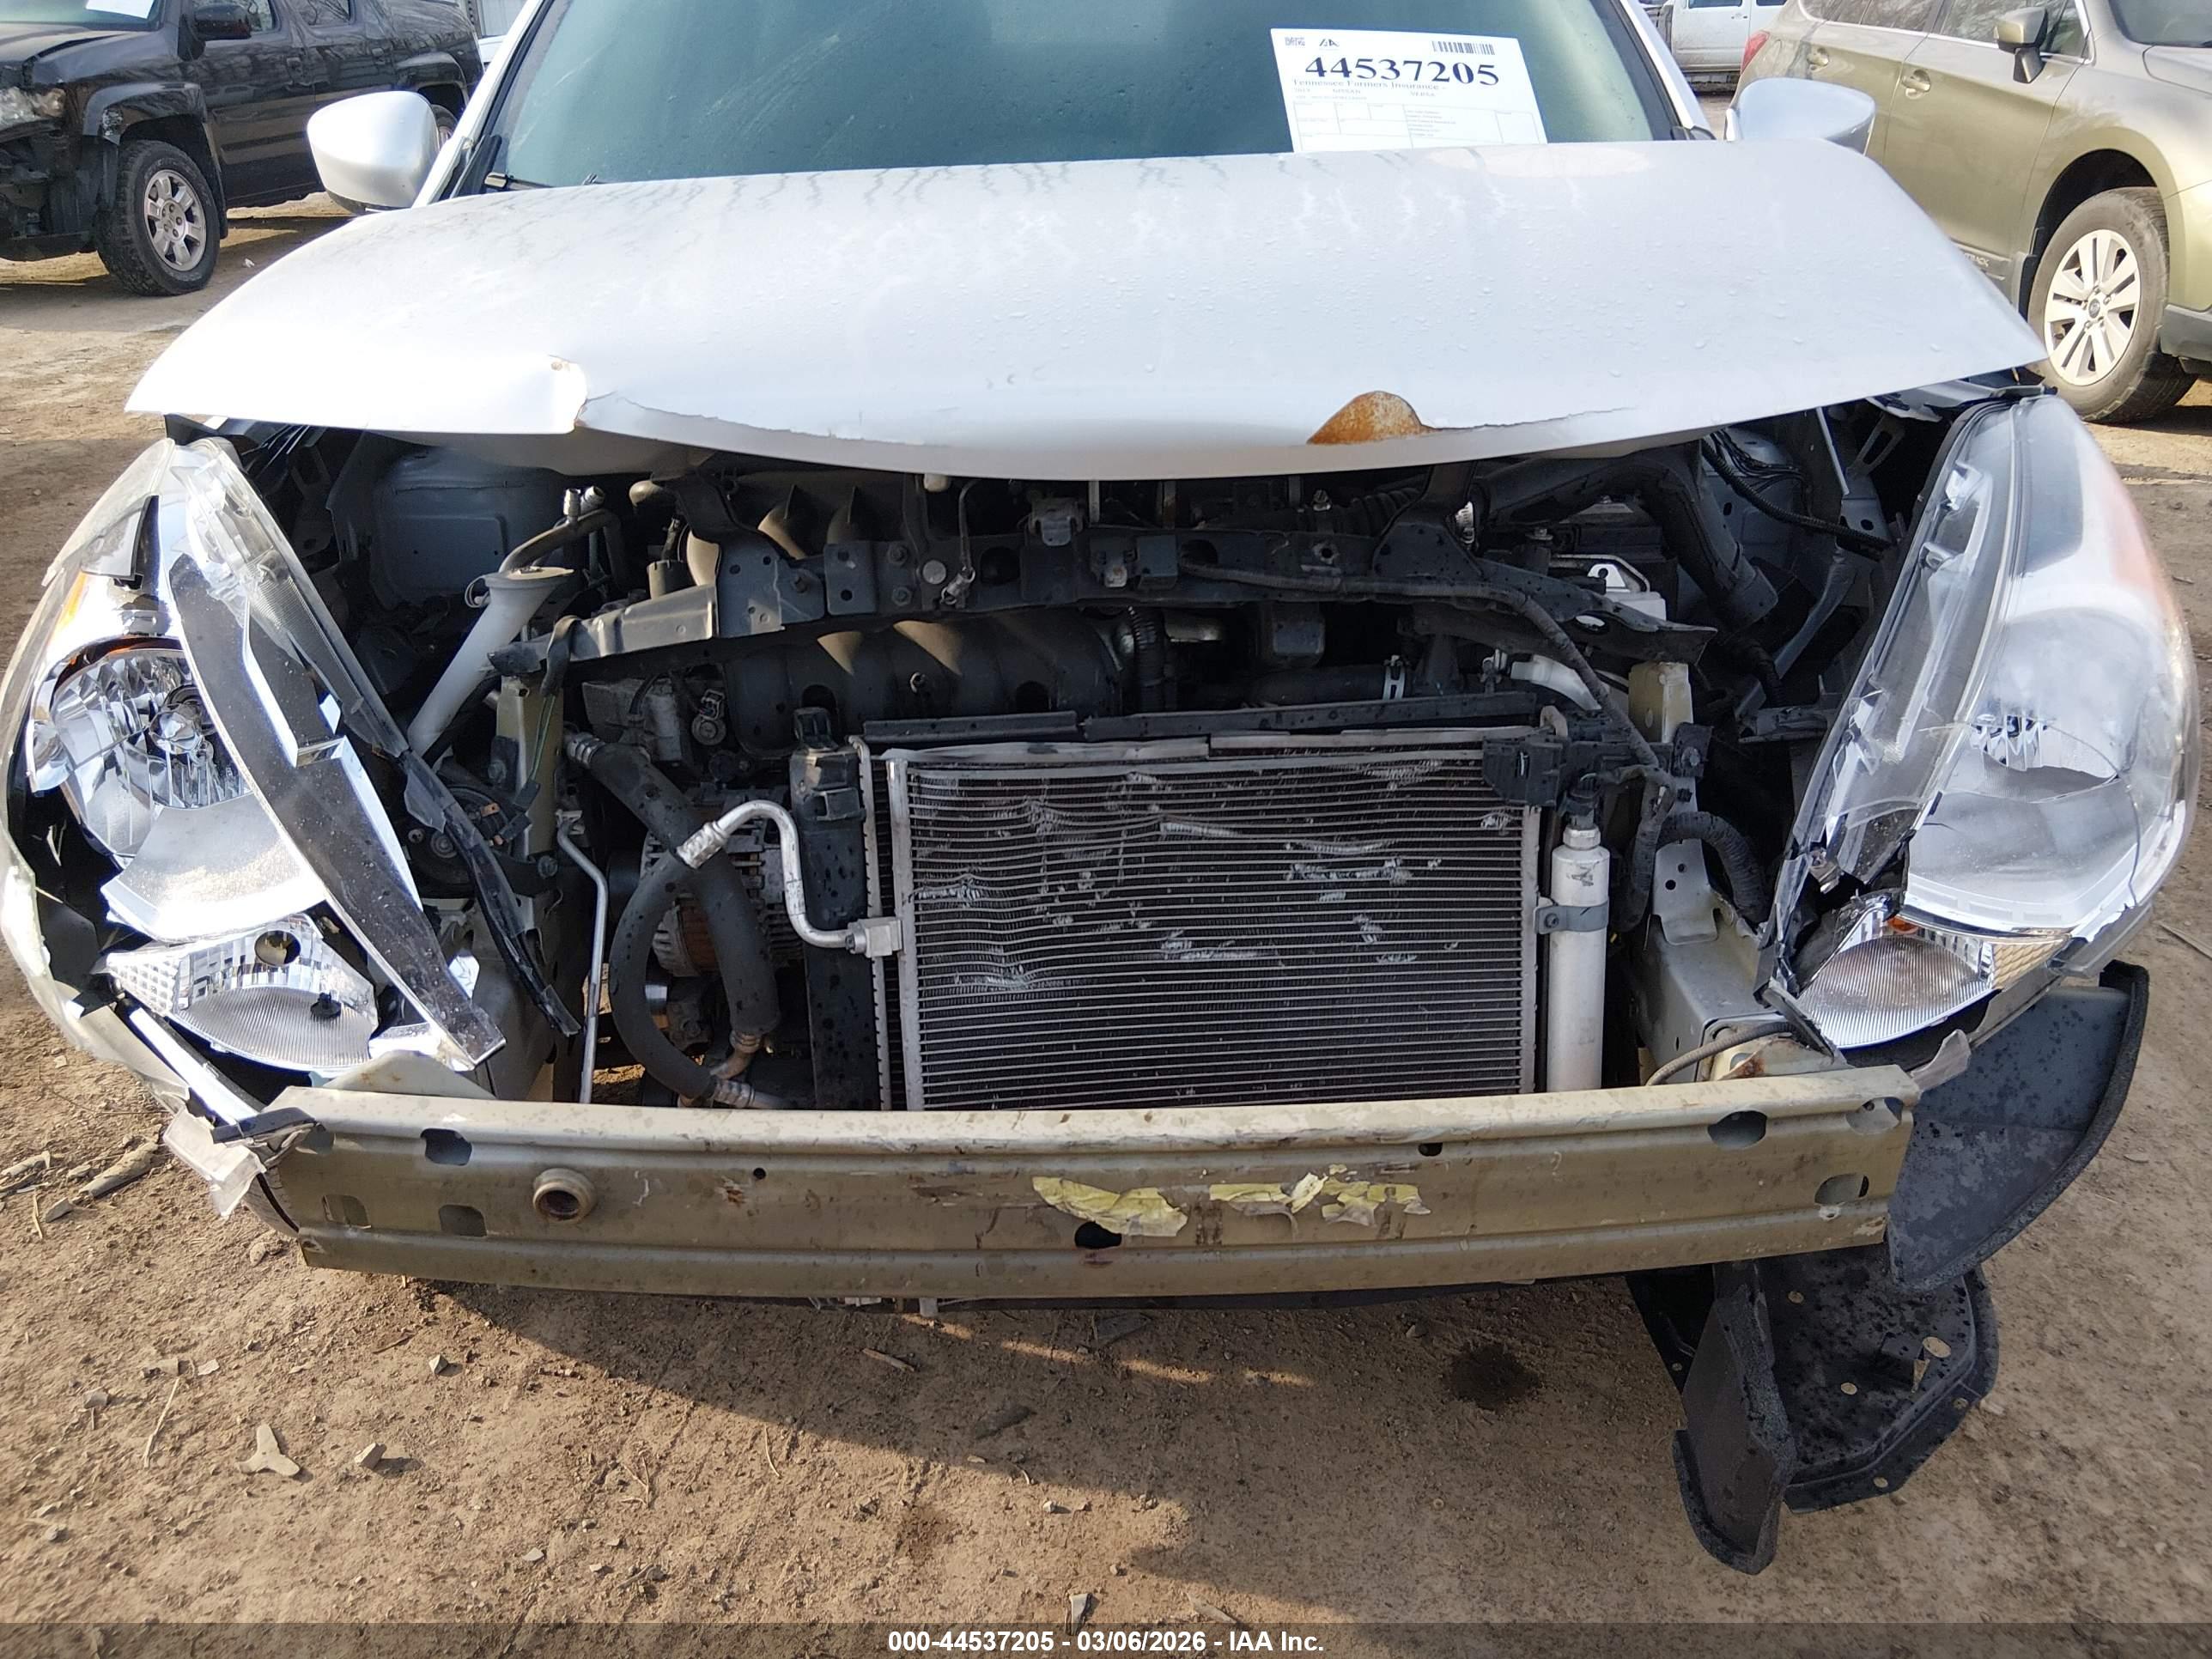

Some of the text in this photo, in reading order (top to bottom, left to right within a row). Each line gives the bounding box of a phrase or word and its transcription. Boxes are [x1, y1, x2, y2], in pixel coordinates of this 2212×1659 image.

[1305, 57, 1499, 86] 44537205
[1347, 80, 1389, 88] Farmers
[1391, 82, 1439, 90] Insurance
